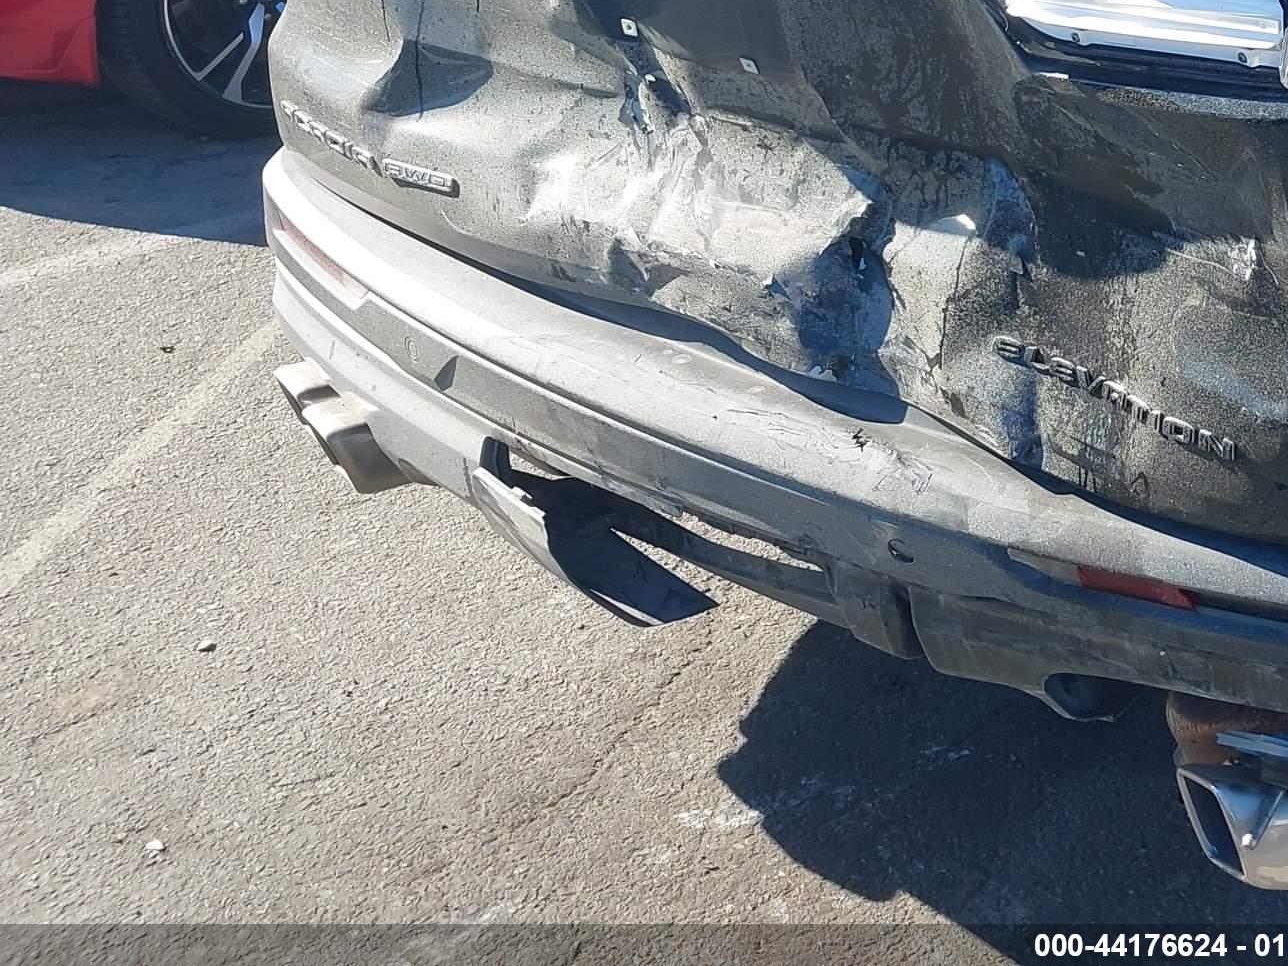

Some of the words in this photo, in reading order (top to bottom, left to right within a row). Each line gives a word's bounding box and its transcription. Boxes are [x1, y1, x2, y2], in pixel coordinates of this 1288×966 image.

[280, 100, 375, 169] ACADIA
[384, 161, 447, 187] AWD
[992, 335, 1237, 461] ELEVATION
